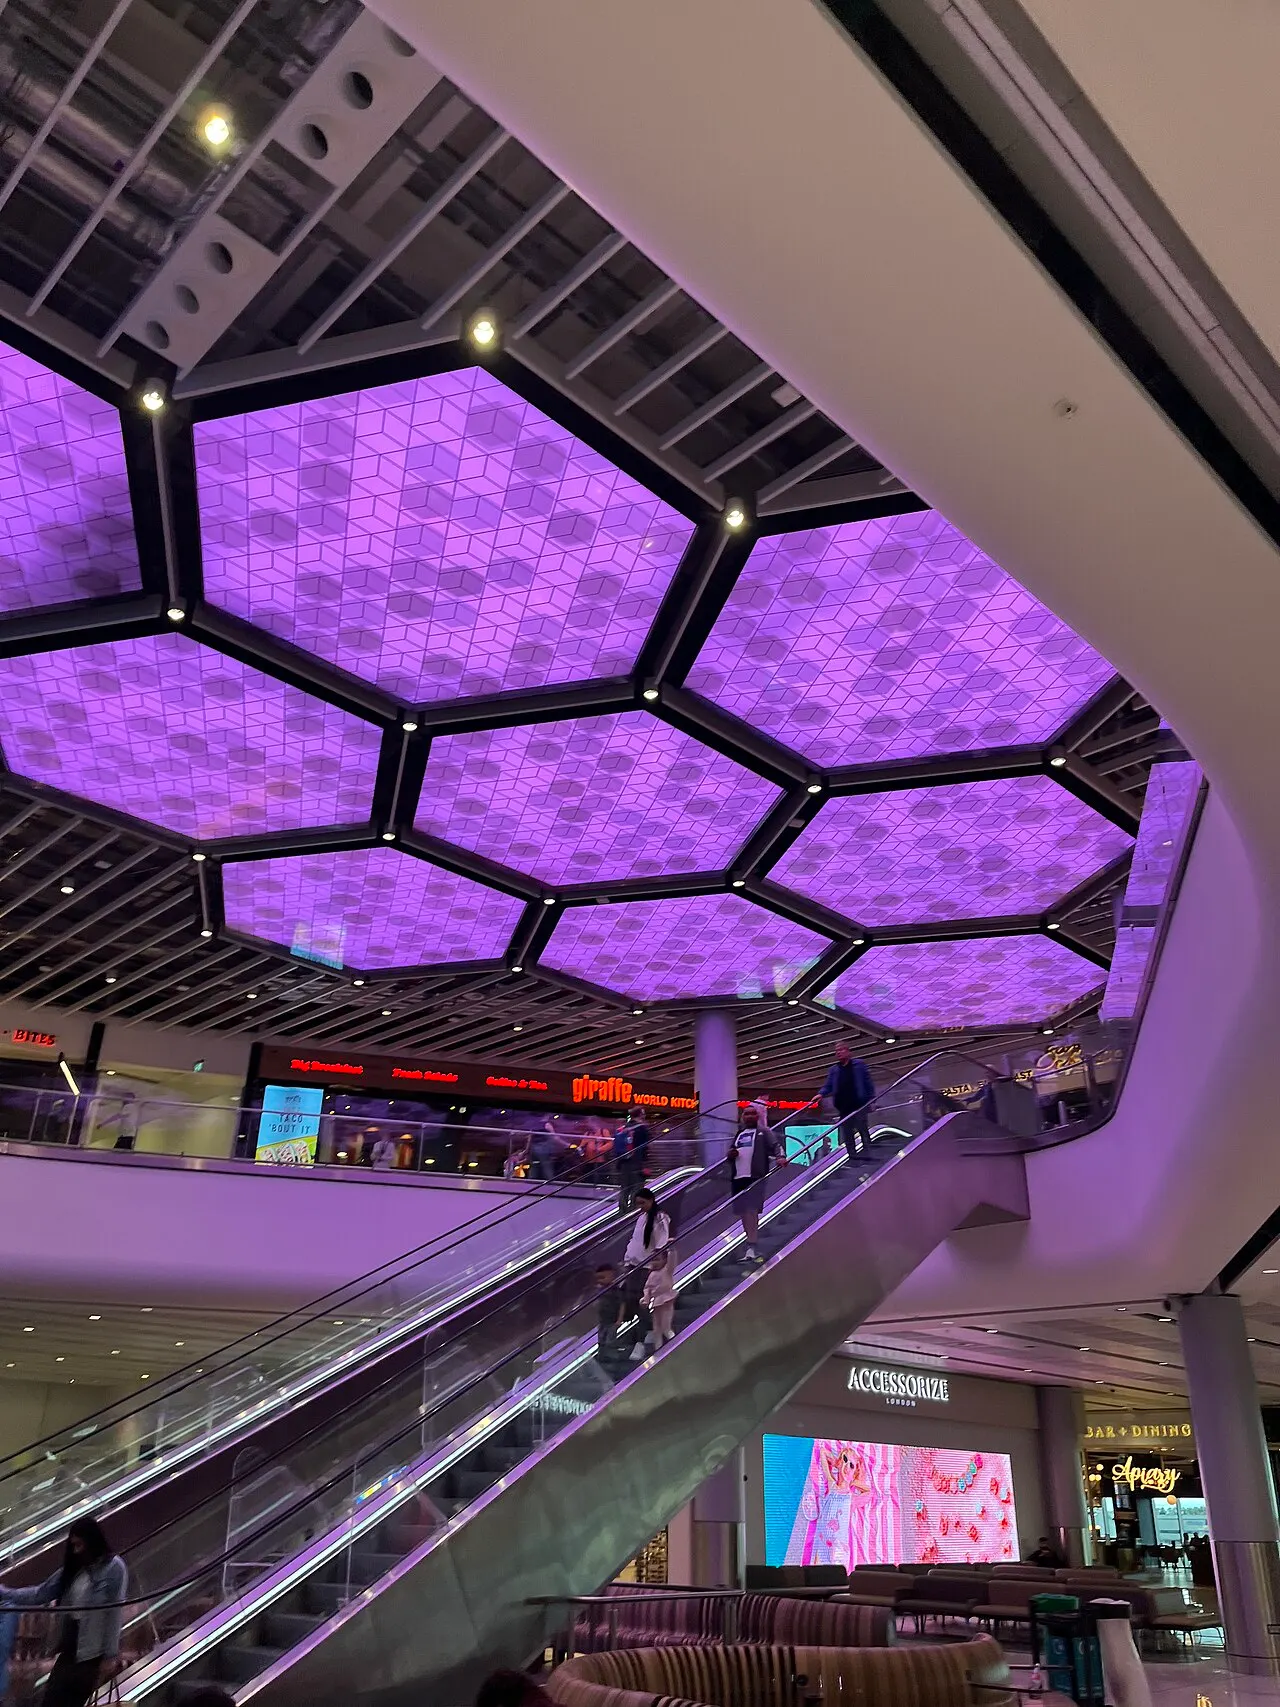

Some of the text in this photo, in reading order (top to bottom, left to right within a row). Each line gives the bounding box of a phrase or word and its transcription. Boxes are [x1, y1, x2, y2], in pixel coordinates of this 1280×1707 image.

[13, 1029, 56, 1047] BITES
[573, 1075, 632, 1103] giraffe
[633, 1094, 668, 1106] WORLD
[280, 1113, 303, 1123] TACO
[301, 1125, 311, 1134] IT
[847, 1367, 949, 1401] ACCESSORIZE
[886, 1398, 916, 1407] LONDON
[1085, 1426, 1116, 1438] BAR
[1132, 1424, 1191, 1437] DINING
[1112, 1456, 1181, 1493] Apiary
